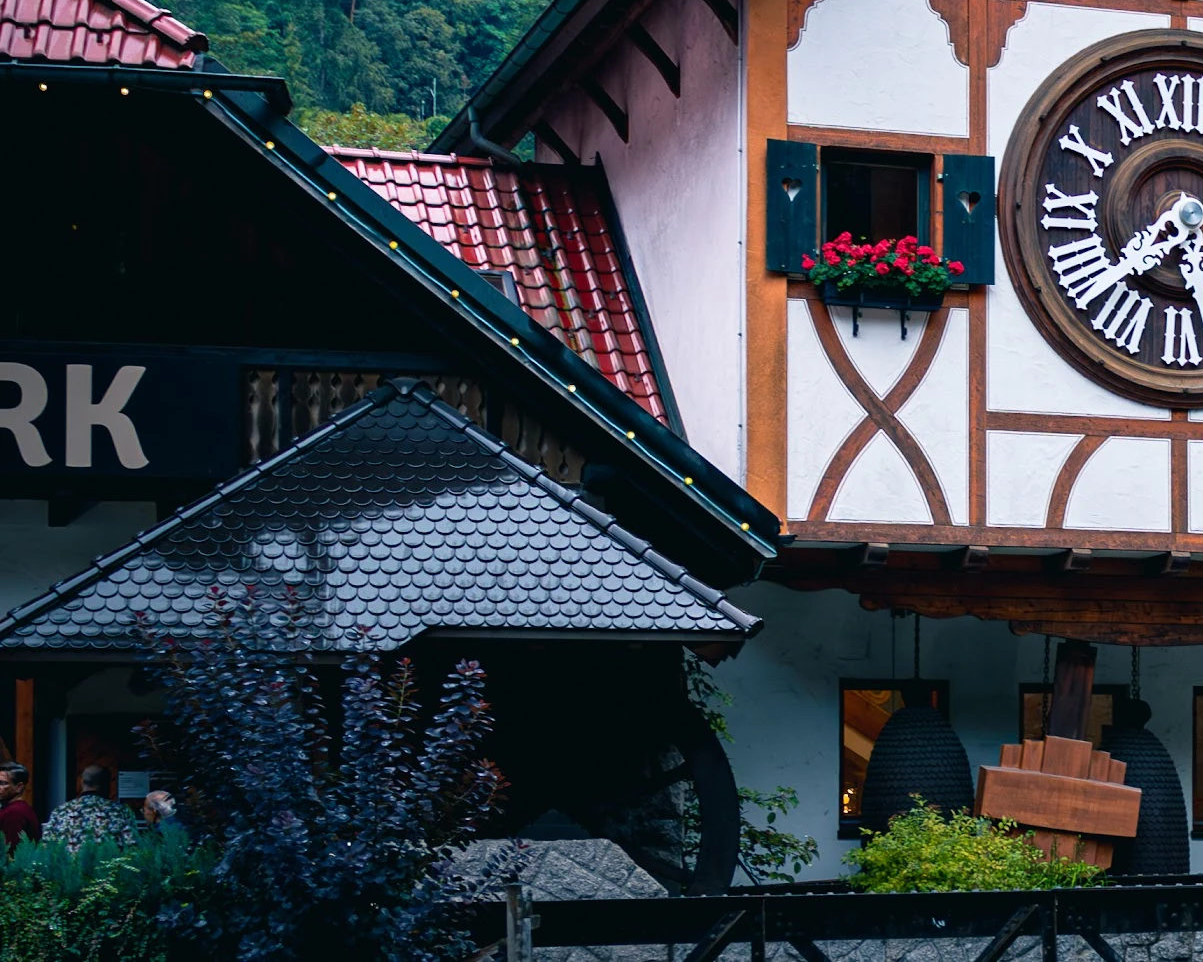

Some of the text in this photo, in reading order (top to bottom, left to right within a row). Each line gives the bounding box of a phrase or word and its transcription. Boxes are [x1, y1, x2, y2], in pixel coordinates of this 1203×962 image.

[1097, 79, 1155, 146] XI
[1058, 125, 1114, 177] X
[1041, 183, 1099, 233] IX
[1091, 281, 1154, 354] VII
[1161, 305, 1203, 366] VI
[0, 361, 149, 469] RK
